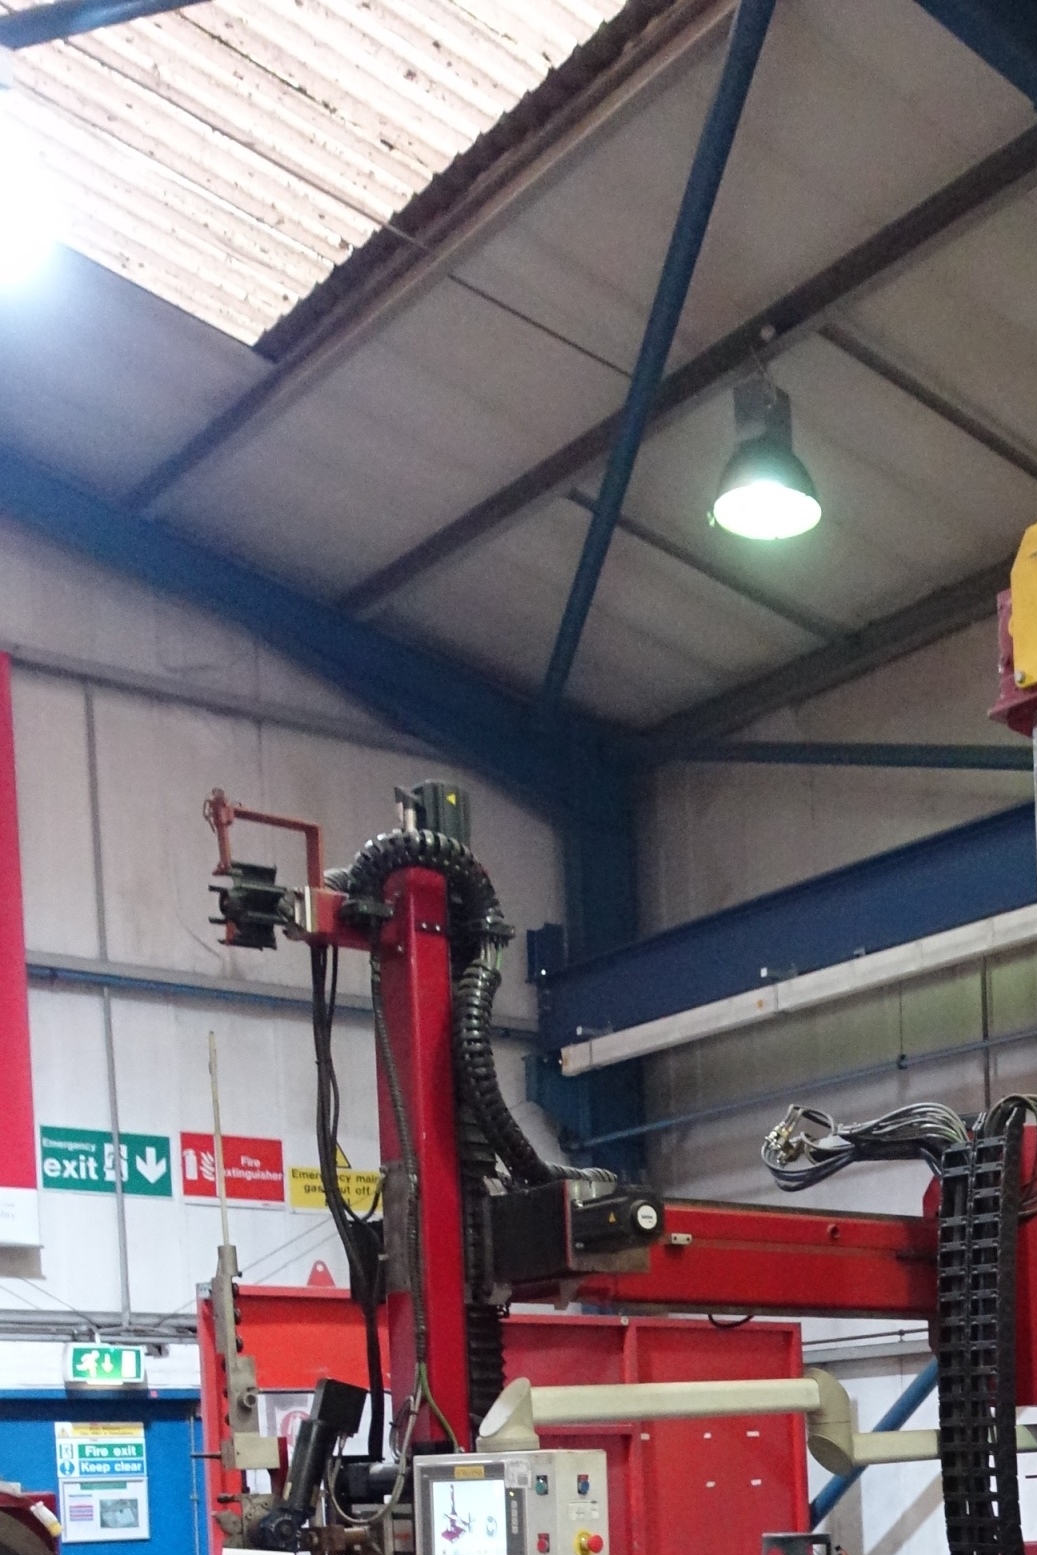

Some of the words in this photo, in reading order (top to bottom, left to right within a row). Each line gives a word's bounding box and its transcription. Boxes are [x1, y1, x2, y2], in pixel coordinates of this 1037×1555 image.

[42, 1137, 97, 1153] Emergency
[43, 1154, 99, 1181] exit
[240, 1155, 261, 1168] Fire
[291, 1168, 352, 1183] Emercy
[355, 1187, 371, 1196] off
[84, 1445, 109, 1457] Fire
[113, 1445, 137, 1457] exit
[81, 1461, 111, 1473] Keep
[113, 1461, 142, 1472] clear
